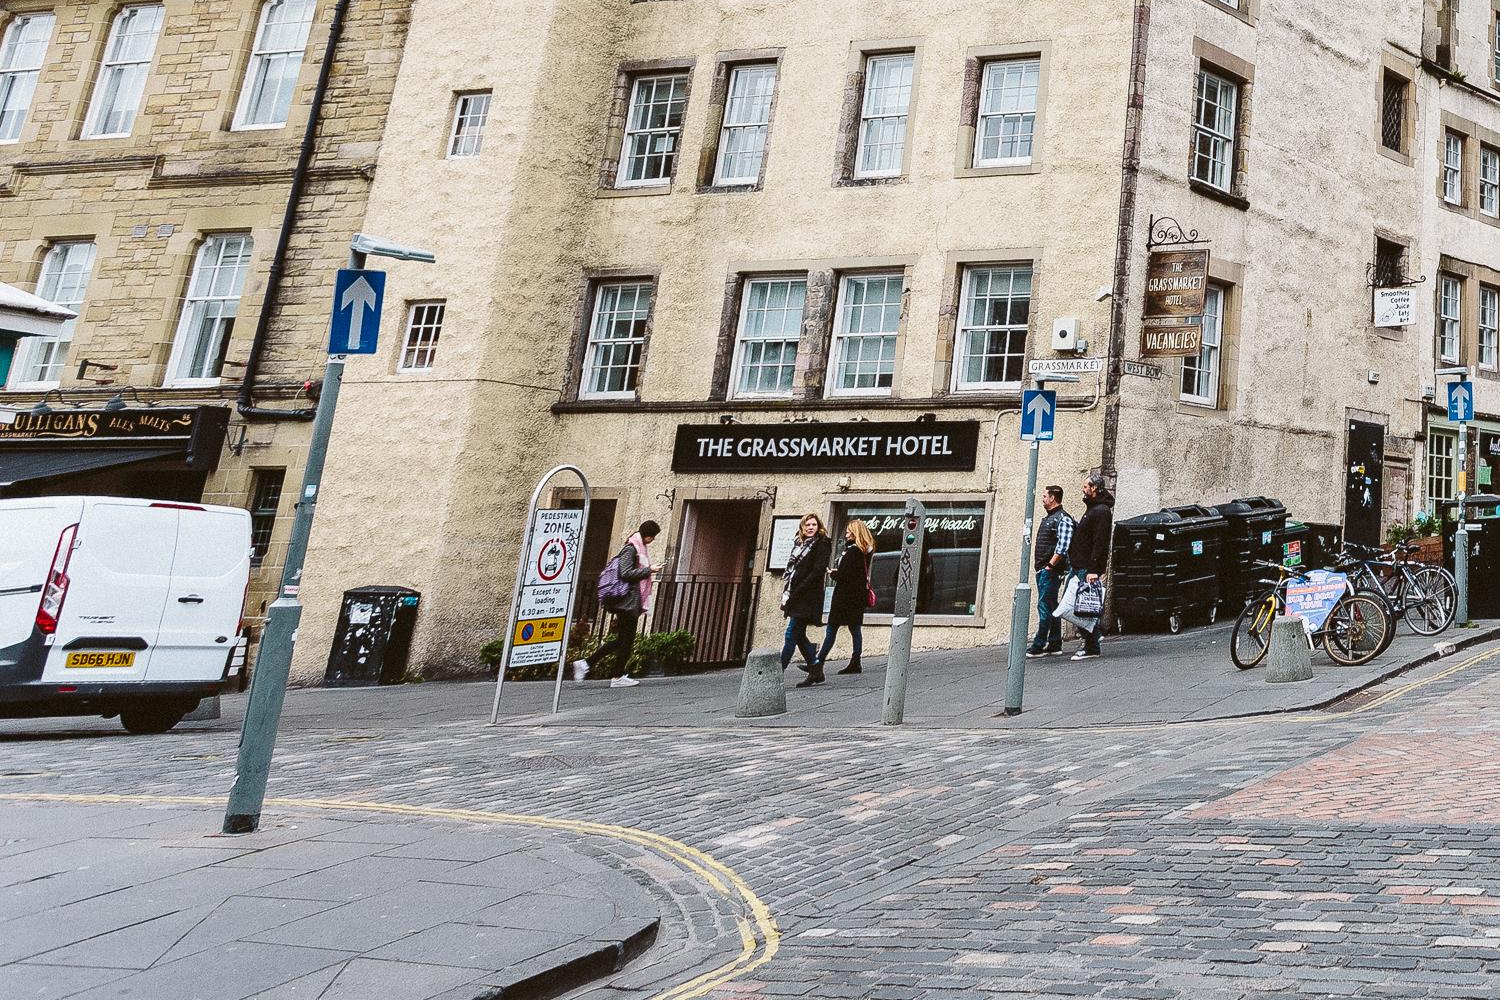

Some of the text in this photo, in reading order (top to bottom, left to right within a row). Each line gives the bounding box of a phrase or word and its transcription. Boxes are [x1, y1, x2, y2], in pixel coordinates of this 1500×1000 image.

[1172, 262, 1183, 272] THE
[1148, 276, 1204, 292] GRASSMARKET
[1381, 290, 1410, 298] Smoothies
[1165, 295, 1182, 306] HOTEL
[1146, 332, 1196, 350] VACANCIES
[1031, 360, 1099, 371] GRASSMARKET
[1127, 363, 1160, 377] WEST BOW
[139, 415, 170, 431] MALTS
[697, 436, 952, 457] THE GRASSMARKET HOTEL
[544, 523, 571, 533] ZONE
[106, 653, 131, 665] HJN
